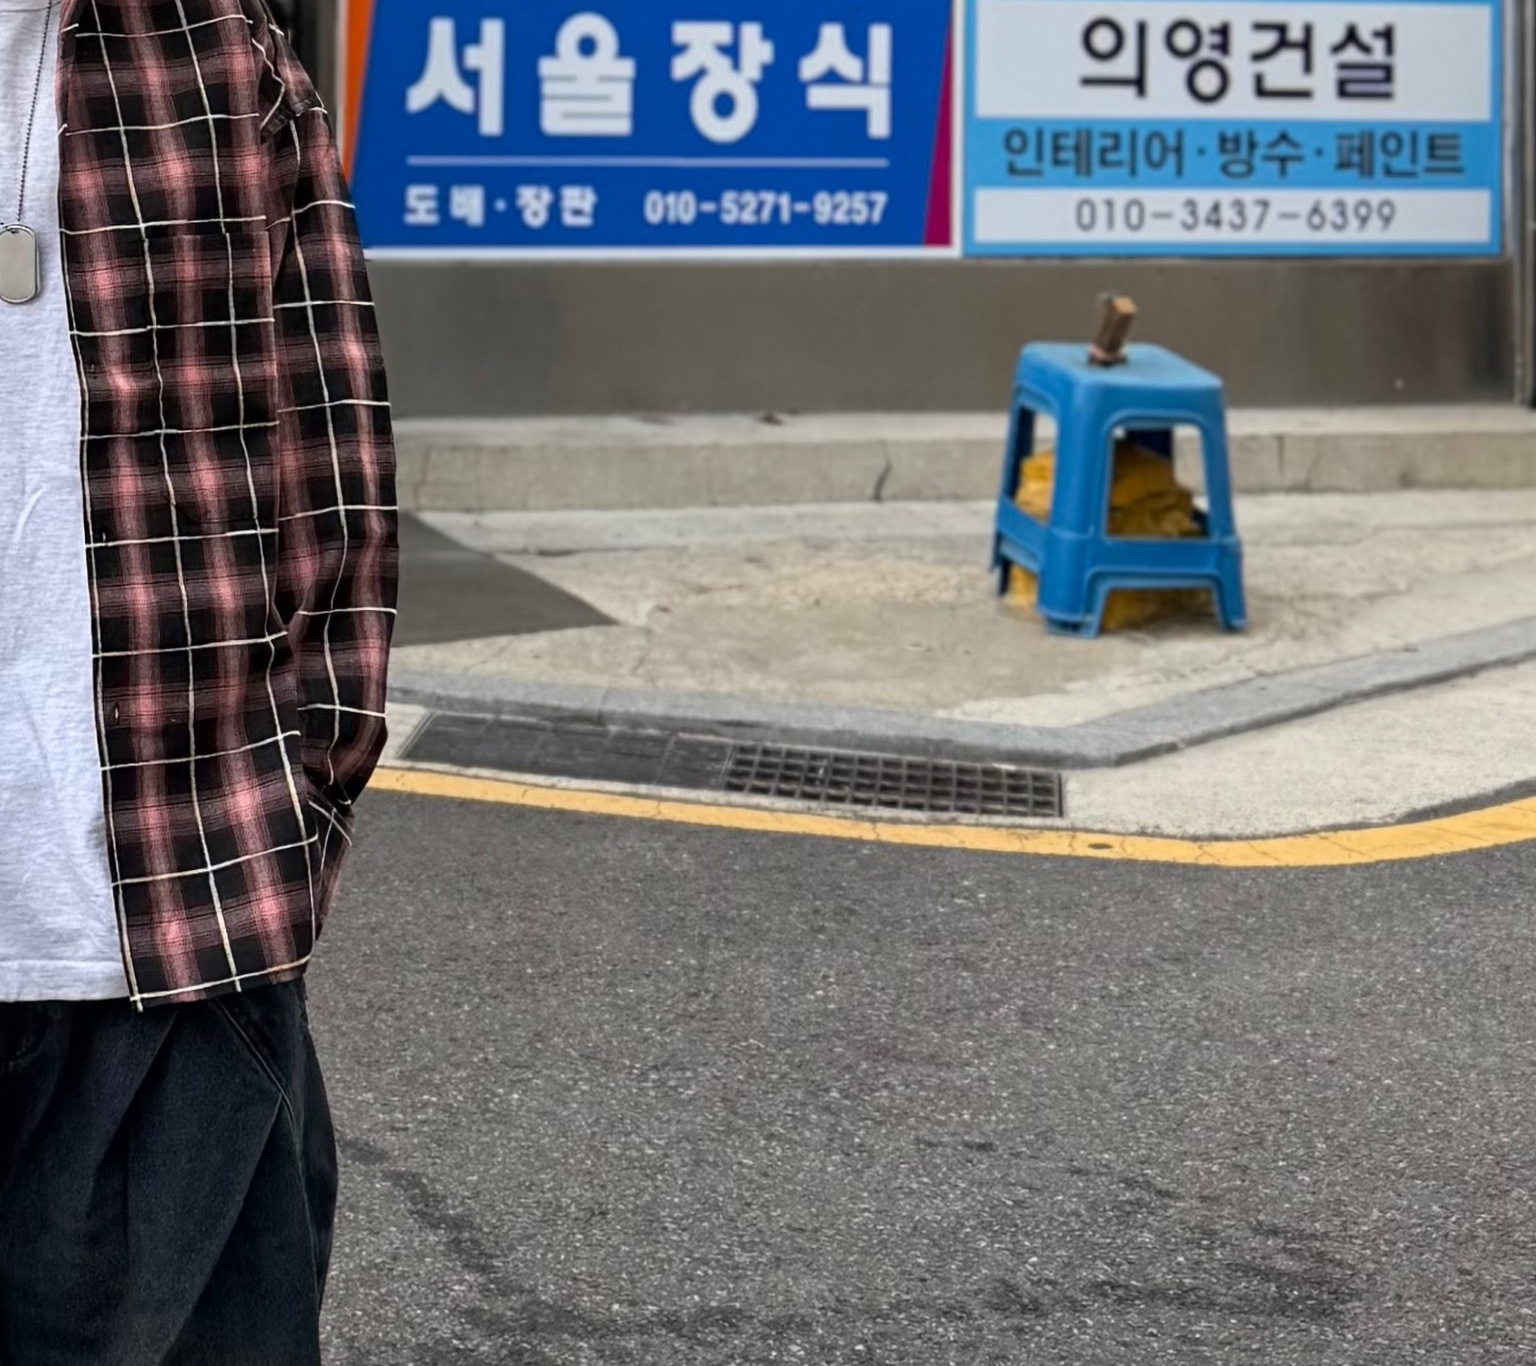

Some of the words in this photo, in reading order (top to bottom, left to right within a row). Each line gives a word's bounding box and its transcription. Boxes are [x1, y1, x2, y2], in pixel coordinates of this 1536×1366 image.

[405, 11, 892, 144] 서울장식
[1078, 16, 1395, 105] 의영건설
[643, 190, 889, 225] 010-5271-9257
[1075, 198, 1397, 234] 010-3437-6399
